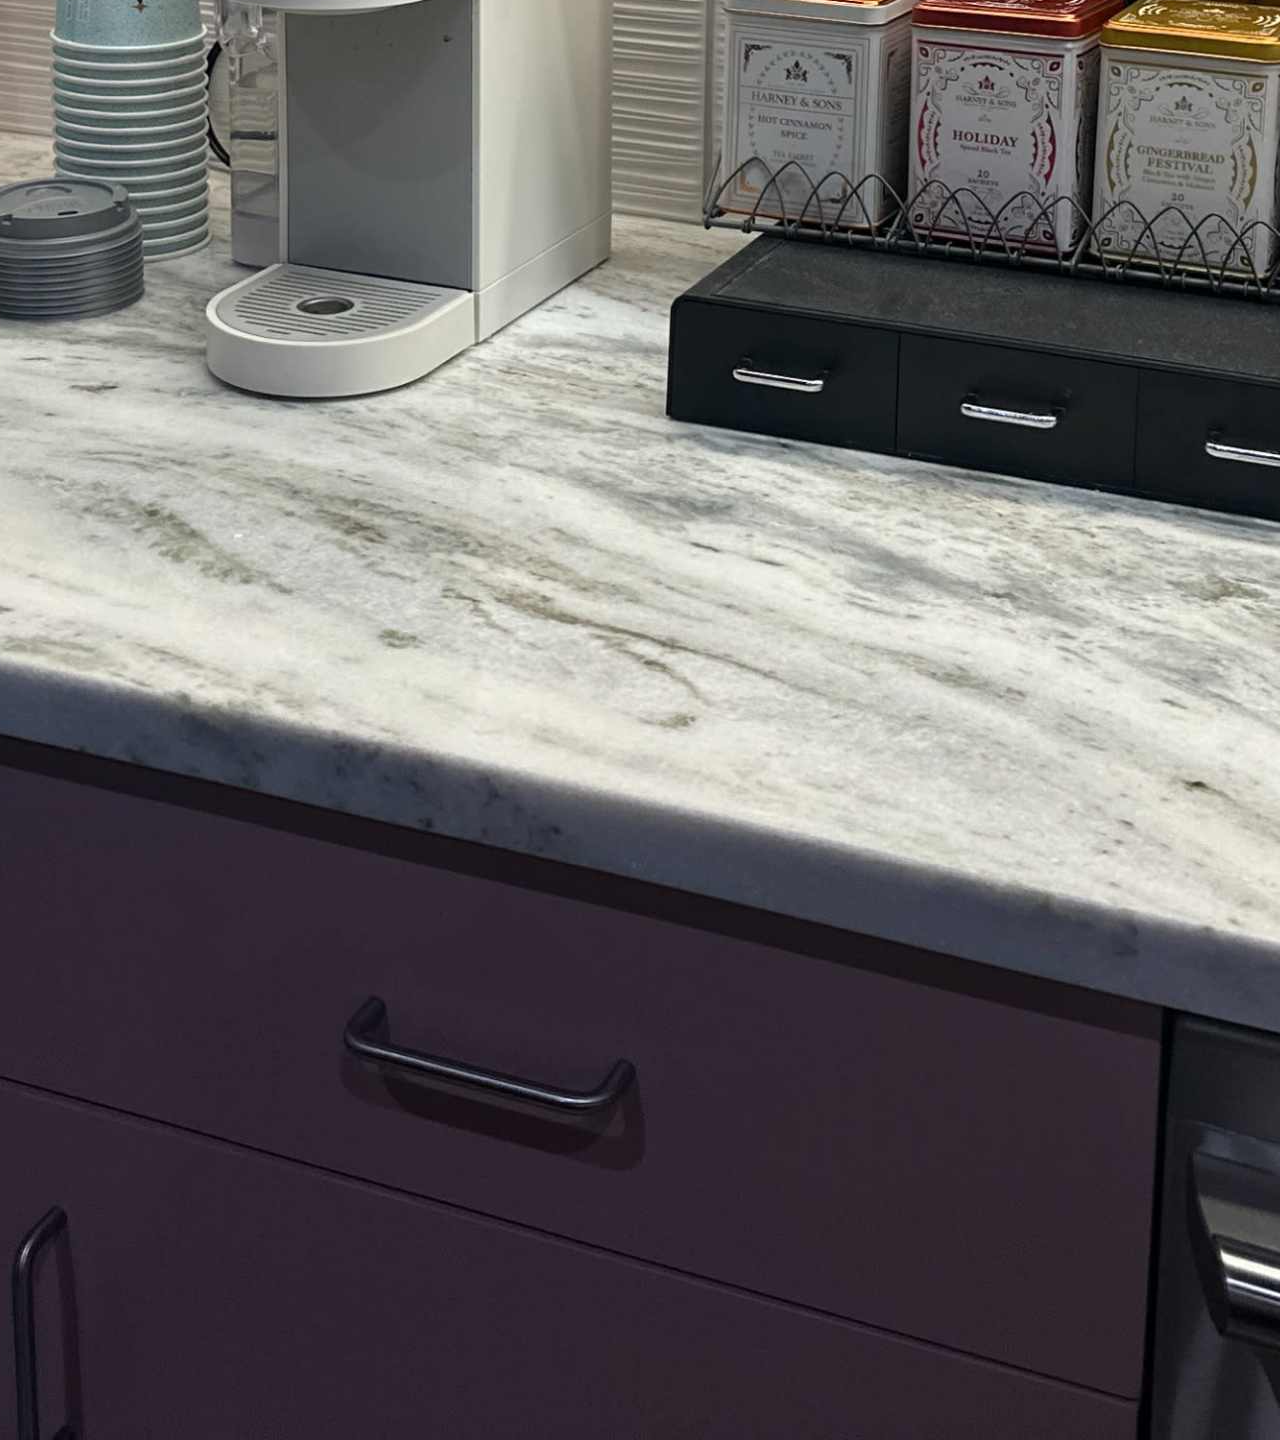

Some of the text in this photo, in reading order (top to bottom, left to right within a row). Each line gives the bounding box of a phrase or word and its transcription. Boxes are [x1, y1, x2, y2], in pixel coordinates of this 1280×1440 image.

[752, 91, 842, 111] HARNEY & SONS
[758, 114, 832, 131] HOT CINNAMON
[952, 129, 1019, 148] HOLIDAY
[1136, 145, 1225, 164] GINGERBREAD
[1147, 157, 1214, 175] FESTIVAL
